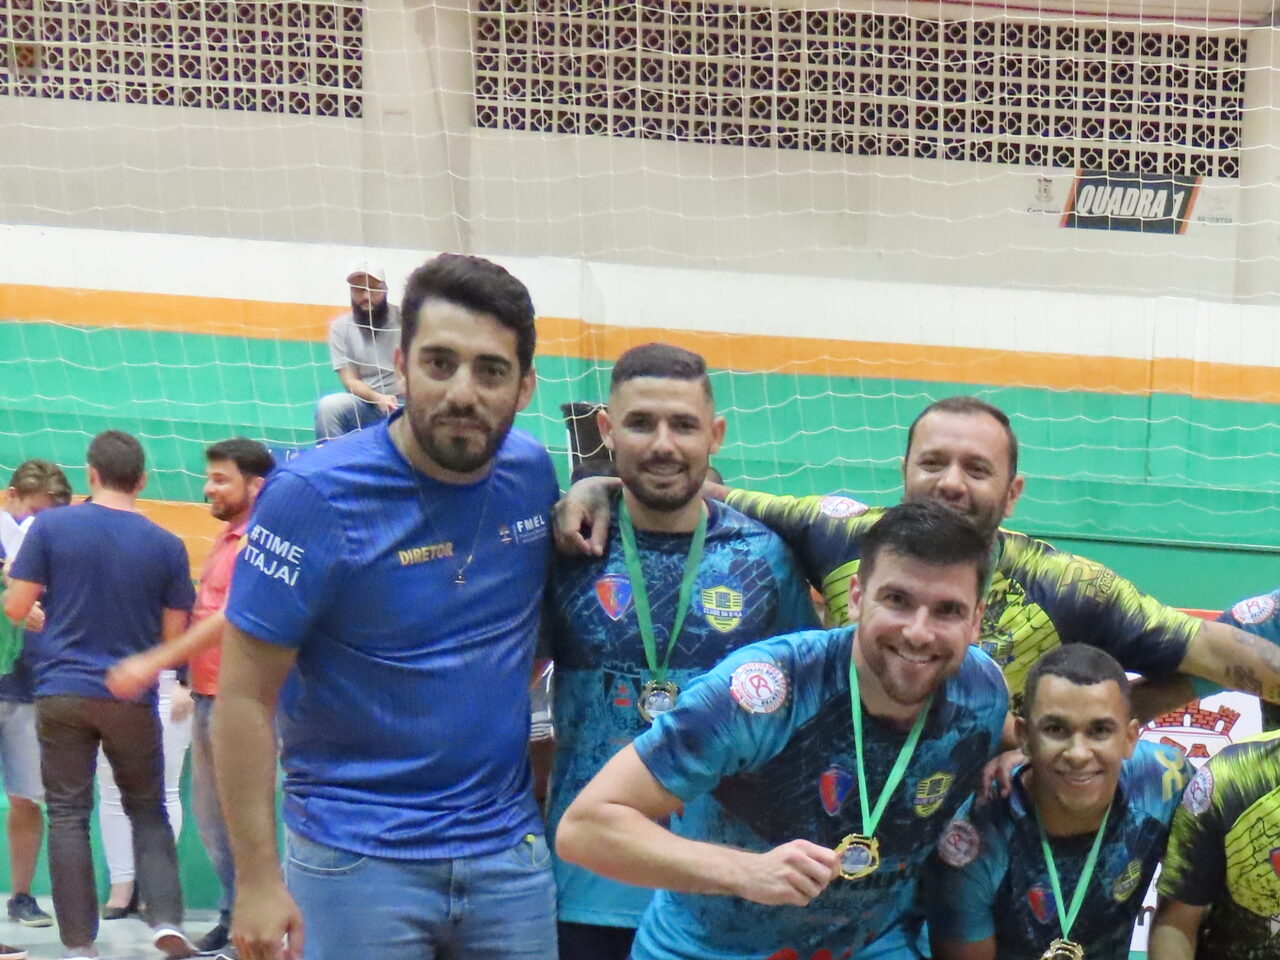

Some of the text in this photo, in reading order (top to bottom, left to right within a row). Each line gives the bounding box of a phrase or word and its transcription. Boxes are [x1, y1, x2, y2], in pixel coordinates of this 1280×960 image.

[1077, 185, 1185, 219] QUADRA 1
[516, 515, 546, 533] FMEL
[250, 523, 305, 565] #TIME
[398, 542, 454, 566] DIRETOR
[244, 544, 301, 587] ITAJAÍ
